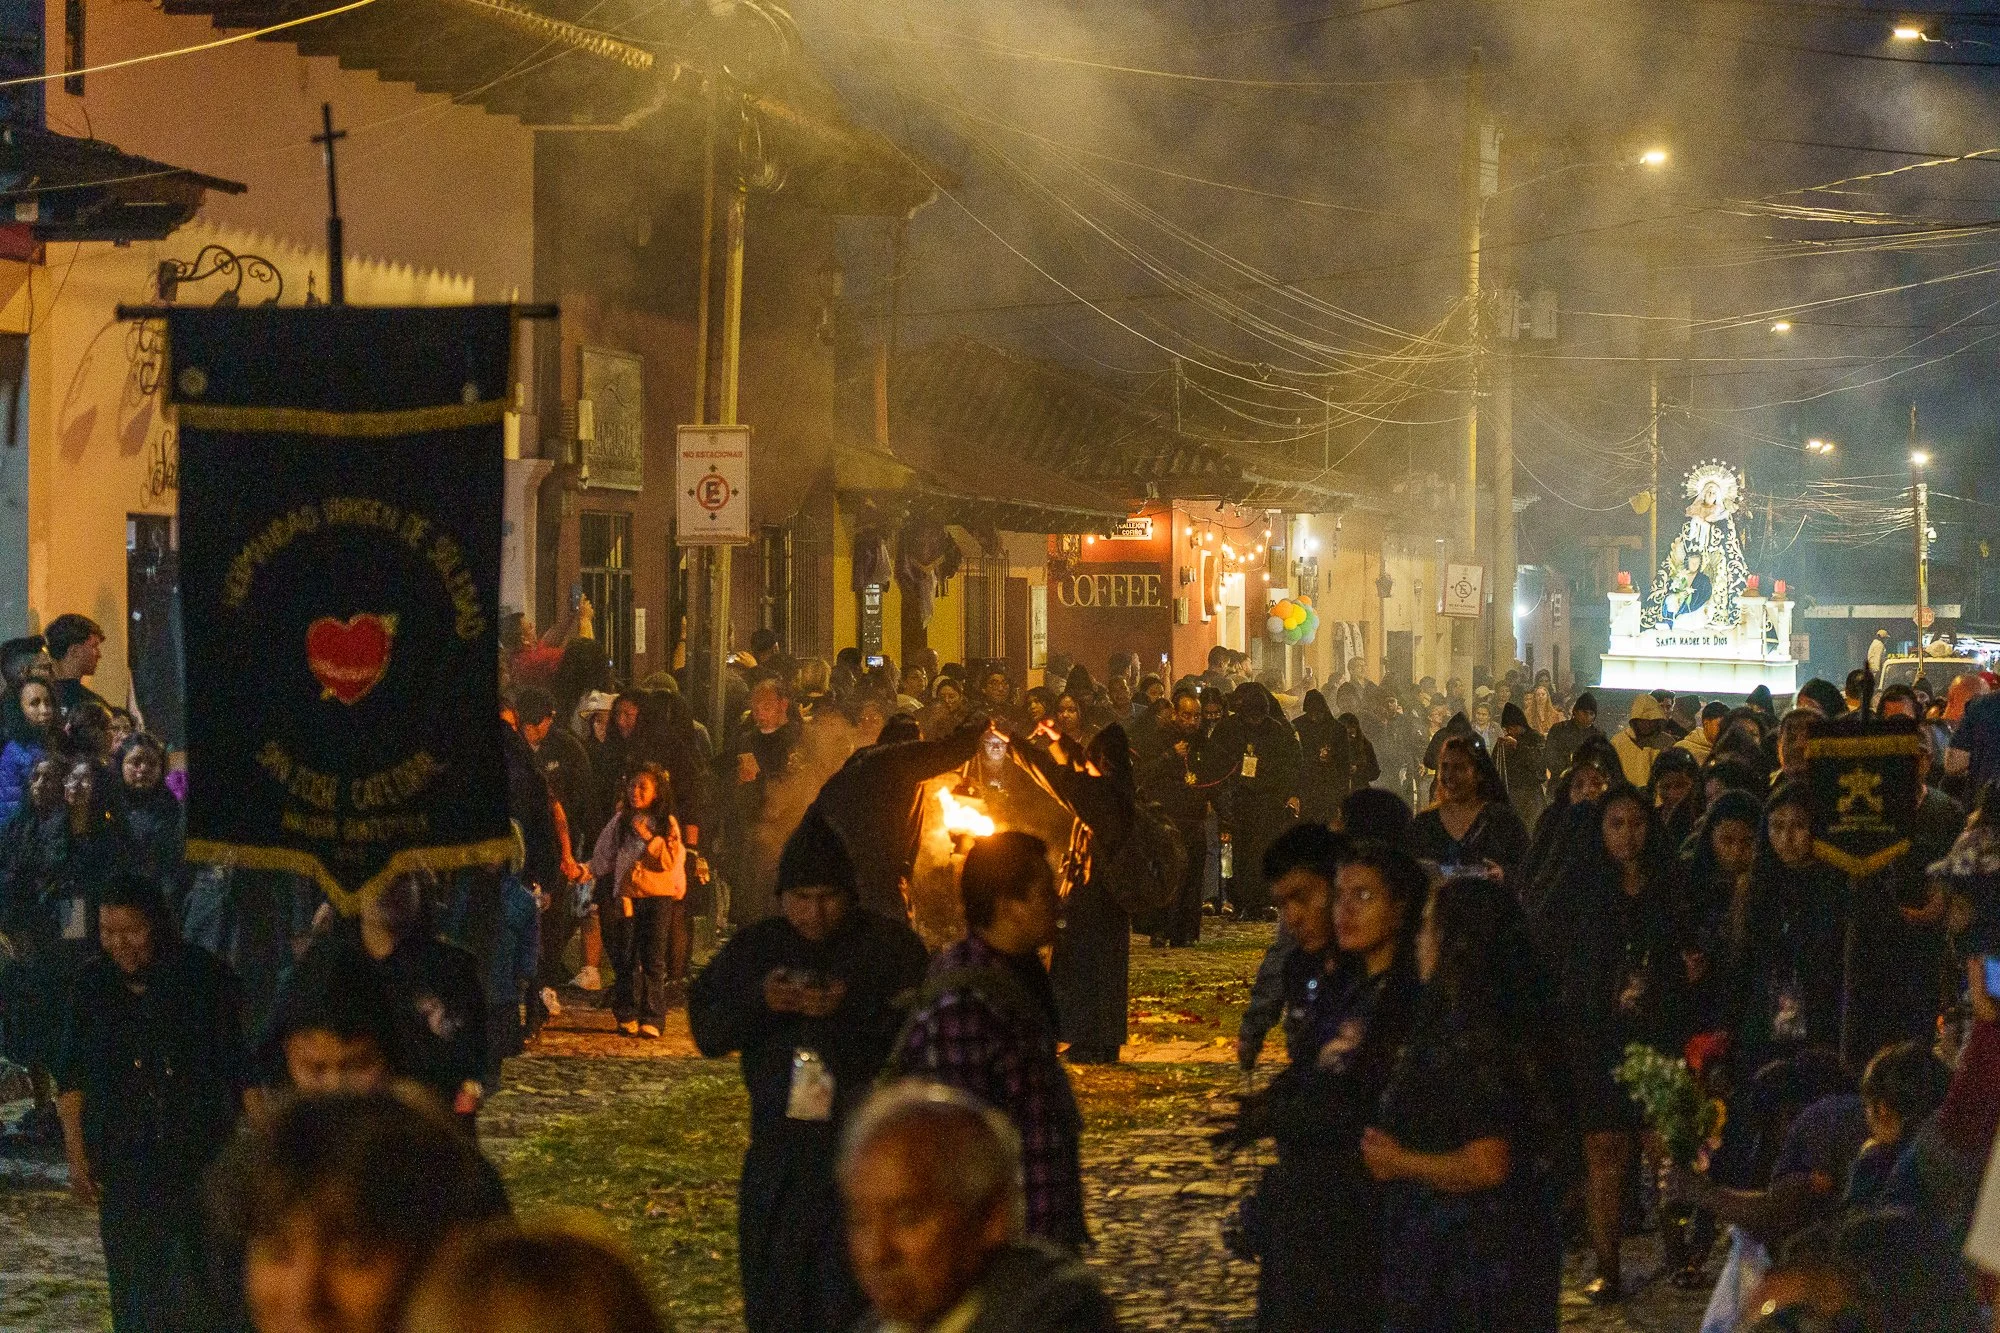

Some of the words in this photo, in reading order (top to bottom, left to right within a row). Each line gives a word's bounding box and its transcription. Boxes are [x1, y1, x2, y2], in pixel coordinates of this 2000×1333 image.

[1057, 574, 1161, 607] COFFEE
[1656, 637, 1677, 647] SANTA
[1680, 637, 1700, 645] MADRE
[1703, 637, 1710, 645] DE
